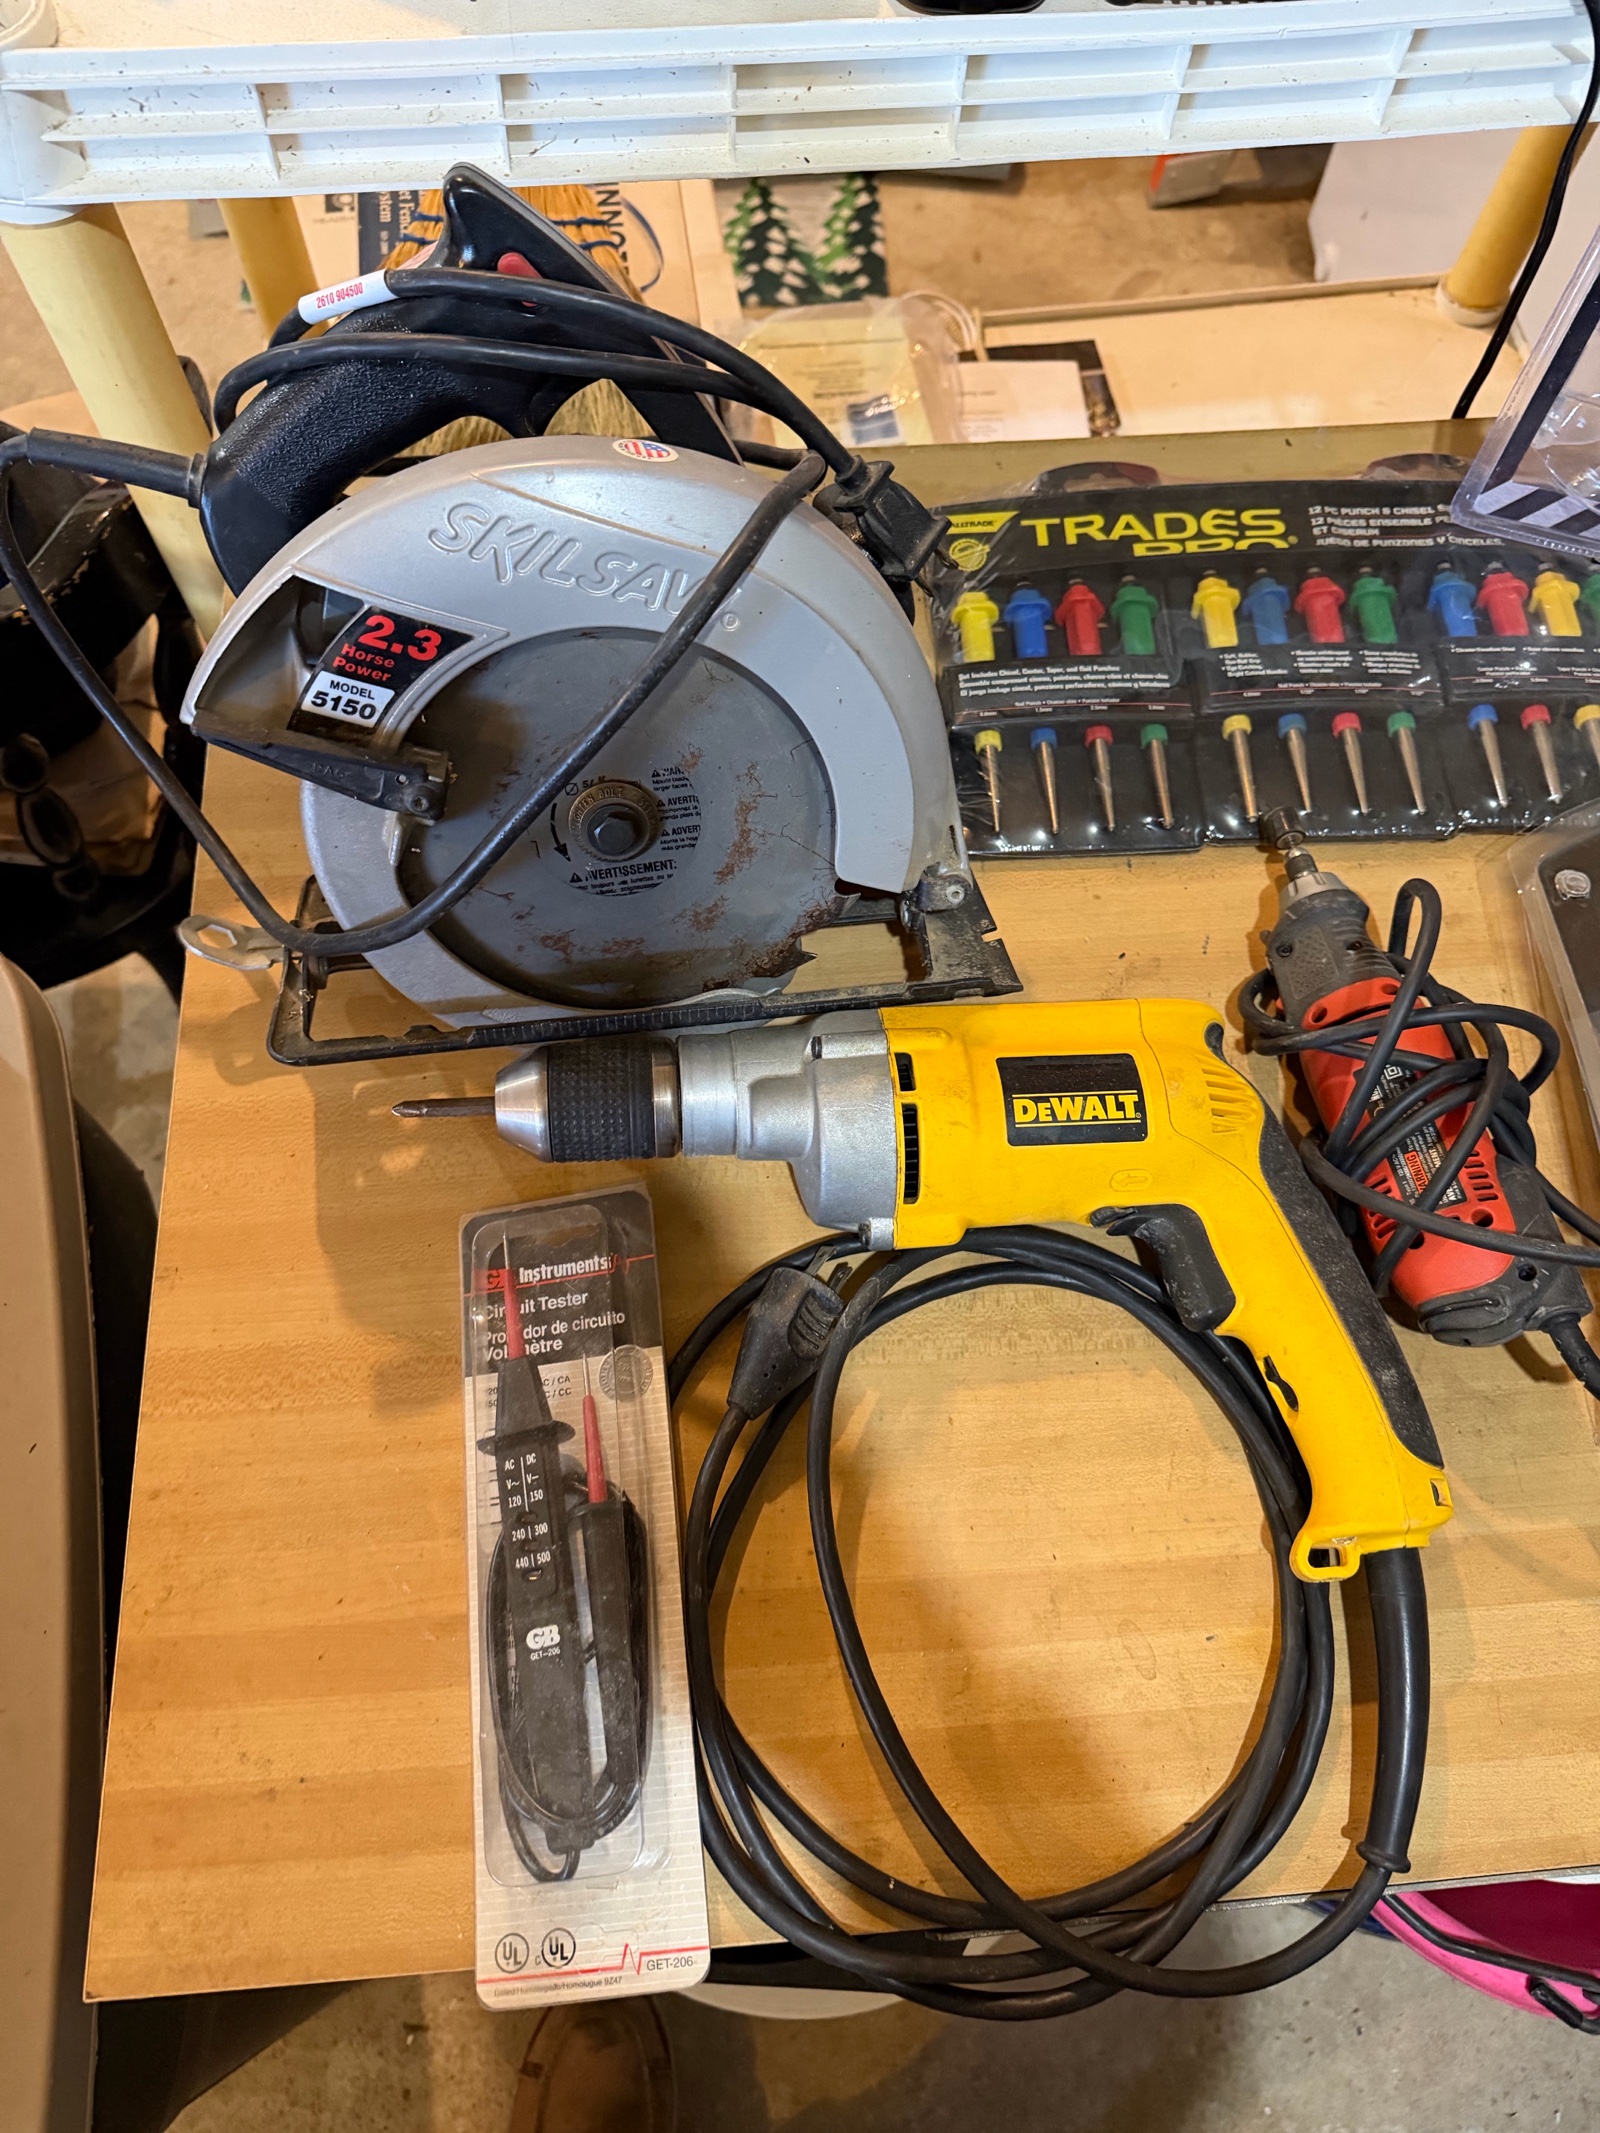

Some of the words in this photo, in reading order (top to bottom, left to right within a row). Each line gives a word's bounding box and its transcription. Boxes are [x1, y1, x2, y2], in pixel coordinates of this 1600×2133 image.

[316, 292, 335, 308] 2610
[336, 282, 363, 301] 904500
[1020, 508, 1286, 547] TRADES
[357, 614, 442, 661] 2.3
[341, 643, 396, 668] Horse
[332, 656, 392, 682] Power
[329, 679, 376, 700] MODEL
[310, 689, 377, 720] 5150
[519, 1255, 612, 1284] Instruments
[538, 1292, 589, 1311] Tester
[551, 1319, 568, 1335] de
[572, 1310, 626, 1332] circuito
[505, 1459, 515, 1471] AC
[526, 1453, 537, 1465] DC
[508, 1495, 522, 1508] 120
[530, 1489, 544, 1502] 150
[512, 1530, 526, 1541] 240
[534, 1522, 549, 1536] 300
[515, 1556, 529, 1569] 440
[536, 1550, 551, 1565] 500
[526, 1624, 561, 1649] GB
[646, 1956, 694, 1971] GET-206
[604, 1977, 623, 1986] 9Z47
